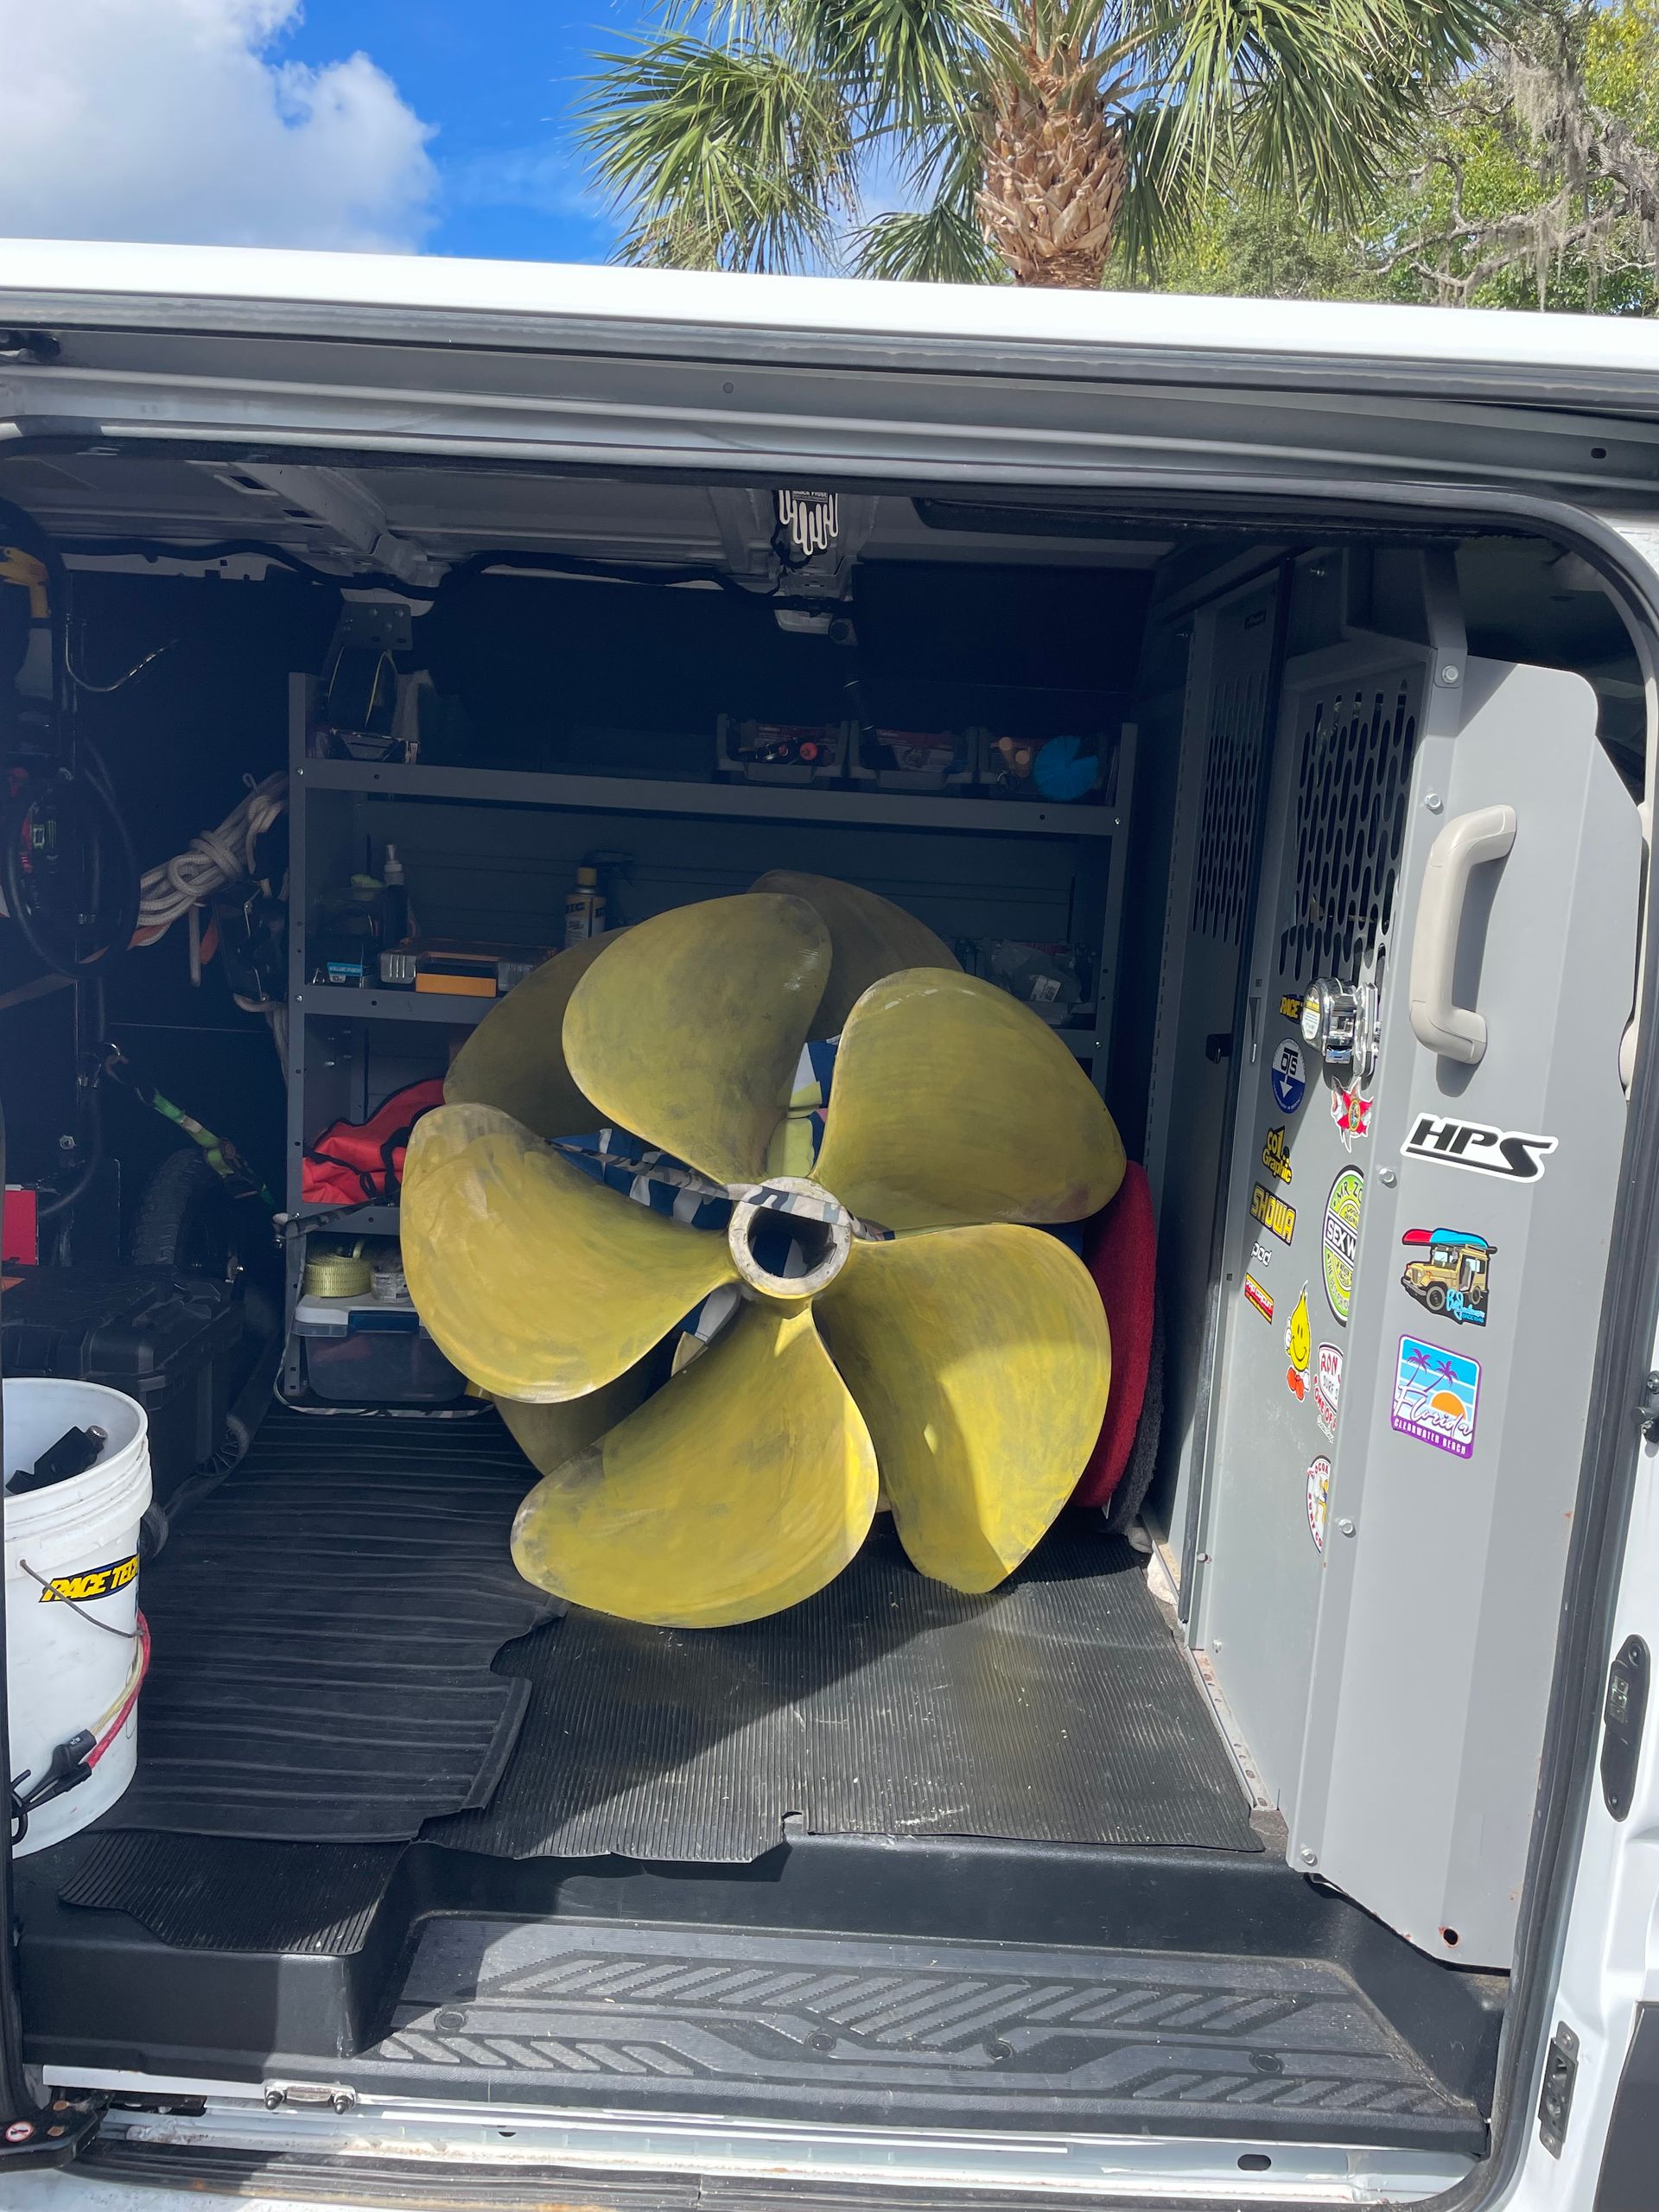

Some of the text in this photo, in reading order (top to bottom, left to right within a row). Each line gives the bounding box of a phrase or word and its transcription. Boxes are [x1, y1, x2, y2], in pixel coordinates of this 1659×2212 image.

[1406, 1118, 1553, 1178] HPS
[1251, 1185, 1295, 1243] SHOWA
[1251, 1242, 1272, 1267] pod
[1321, 1353, 1338, 1376] RON
[1393, 1385, 1472, 1439] Florida
[1394, 1418, 1466, 1455] CLEARWATER BEACH
[41, 1570, 111, 1601] RACE
